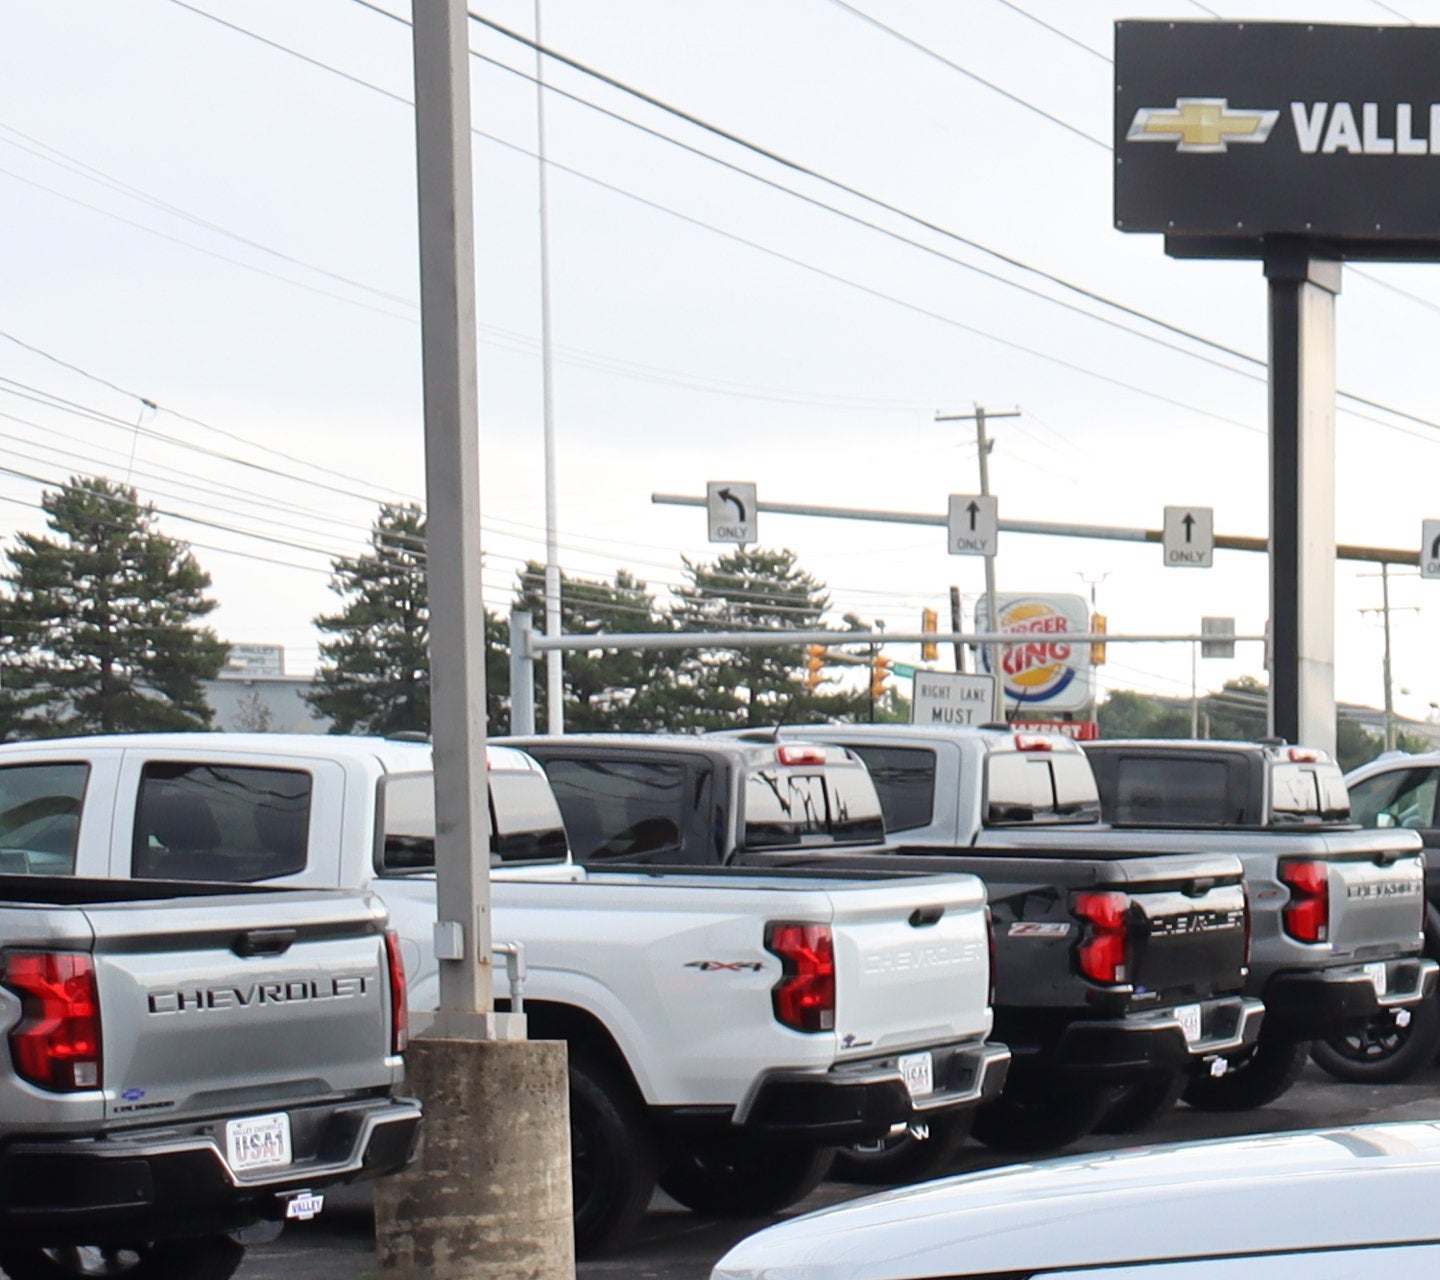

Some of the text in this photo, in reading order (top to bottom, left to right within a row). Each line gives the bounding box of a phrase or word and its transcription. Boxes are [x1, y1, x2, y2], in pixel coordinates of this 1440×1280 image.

[717, 526, 748, 539] ONLY
[957, 537, 988, 550] ONLY
[1169, 551, 1206, 562] ONLY
[921, 684, 985, 702] RIGHT LANE
[931, 705, 973, 725] MUST
[147, 975, 374, 1016] CHEVROLET
[291, 1200, 322, 1214] VALLEY
